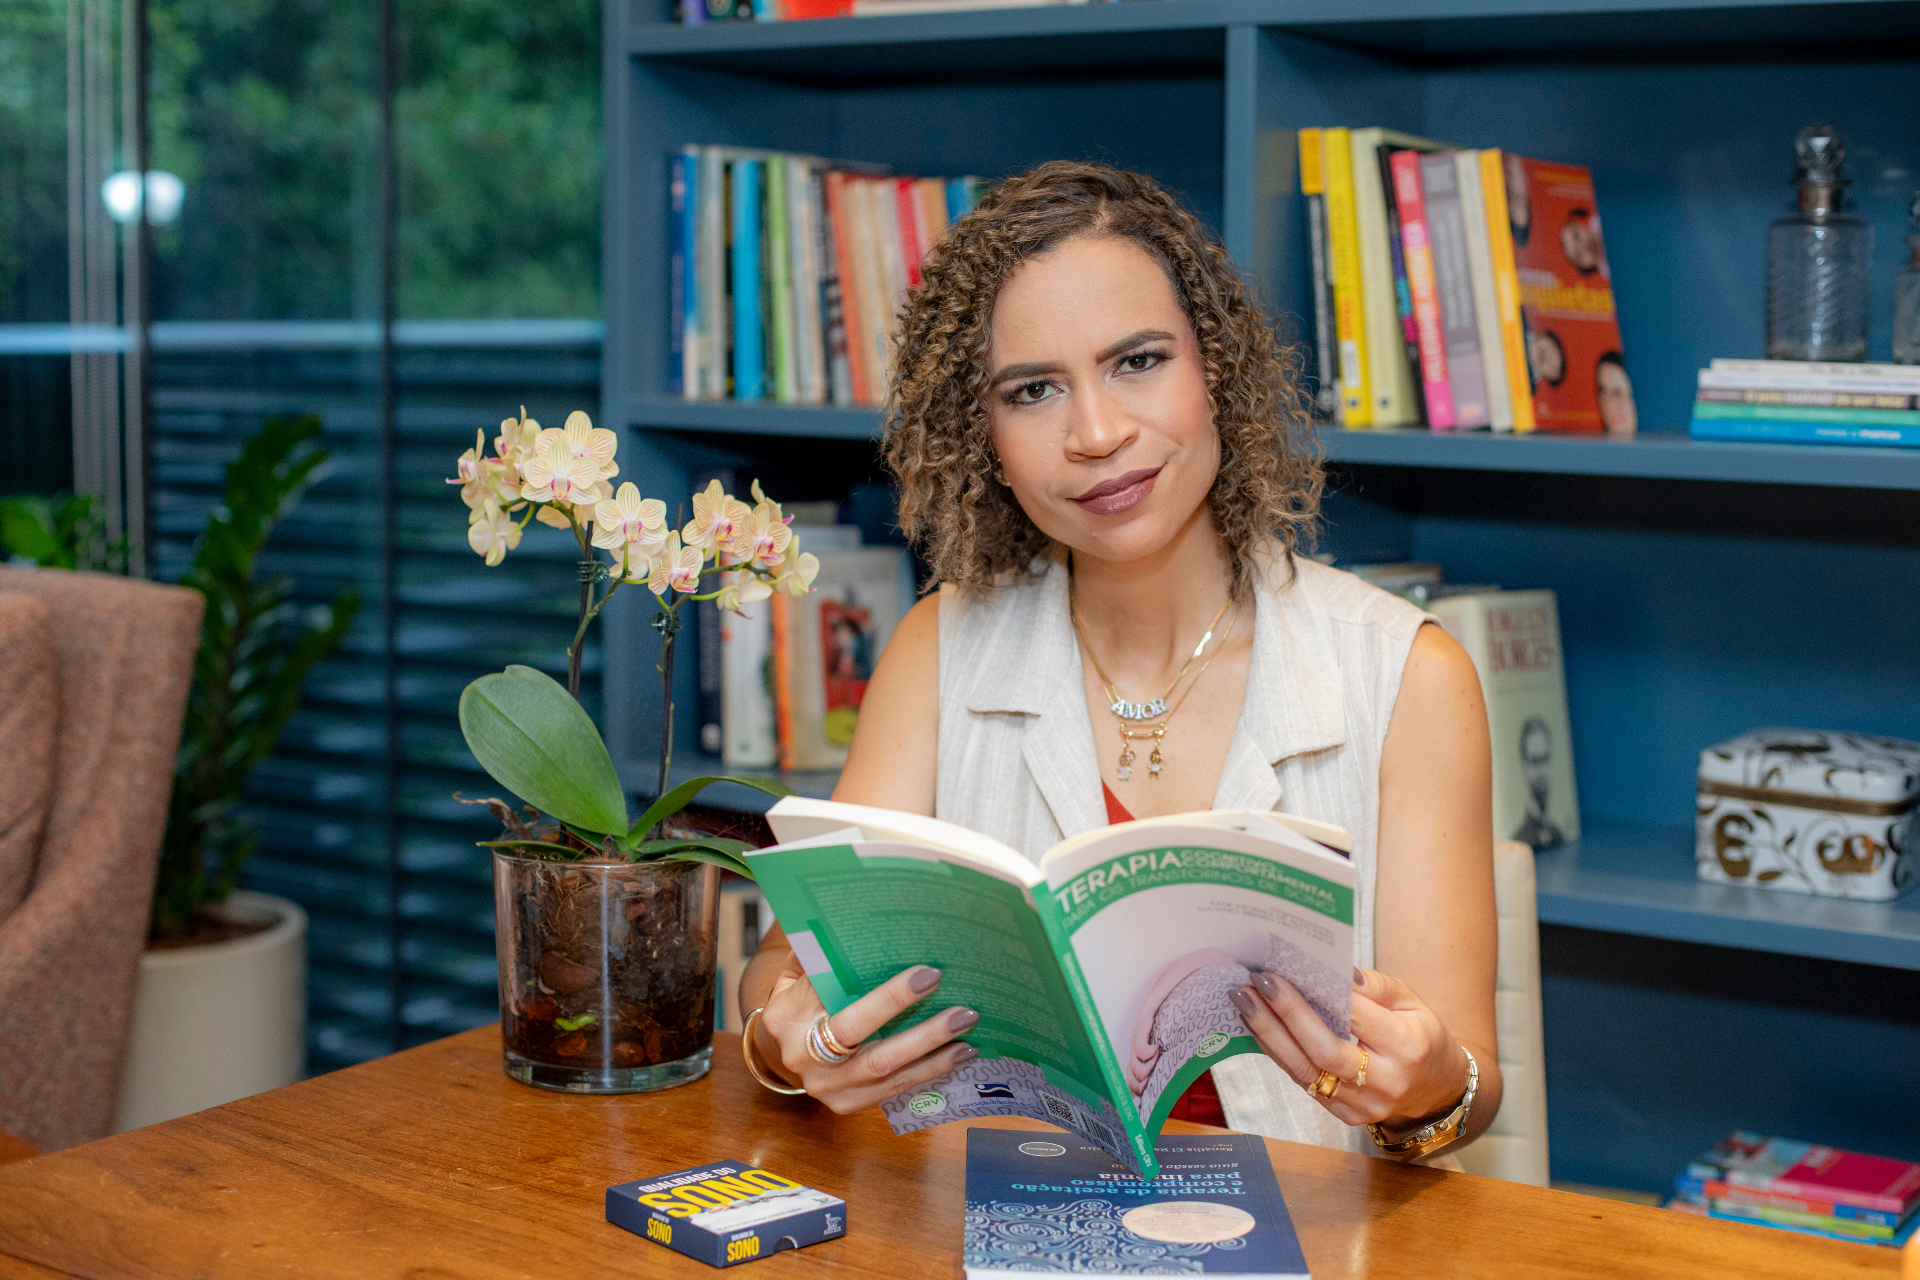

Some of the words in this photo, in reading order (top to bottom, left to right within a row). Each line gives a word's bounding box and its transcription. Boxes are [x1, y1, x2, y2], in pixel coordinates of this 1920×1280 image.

[1110, 698, 1169, 719] AMOR
[1054, 850, 1182, 913] TERAPIA
[1062, 899, 1097, 929] PARA
[1098, 882, 1125, 902] OS
[1128, 868, 1254, 889] TRANSTORNOS
[1201, 1036, 1224, 1051] CRV
[914, 1098, 939, 1110] CRV
[1134, 1133, 1149, 1154] Editora
[1142, 1153, 1152, 1168] CRV
[638, 1171, 718, 1193] QUALIDADE
[711, 1167, 737, 1176] DO
[1070, 1179, 1226, 1188] compromisso
[1098, 1173, 1184, 1182] innia
[1189, 1171, 1242, 1179] para
[638, 1169, 802, 1218] SONO
[1010, 1183, 1119, 1195] aceitação
[1124, 1187, 1151, 1196] de
[1155, 1186, 1246, 1196] Terapia
[647, 1217, 672, 1244] SONO
[727, 1236, 759, 1262] SONO
